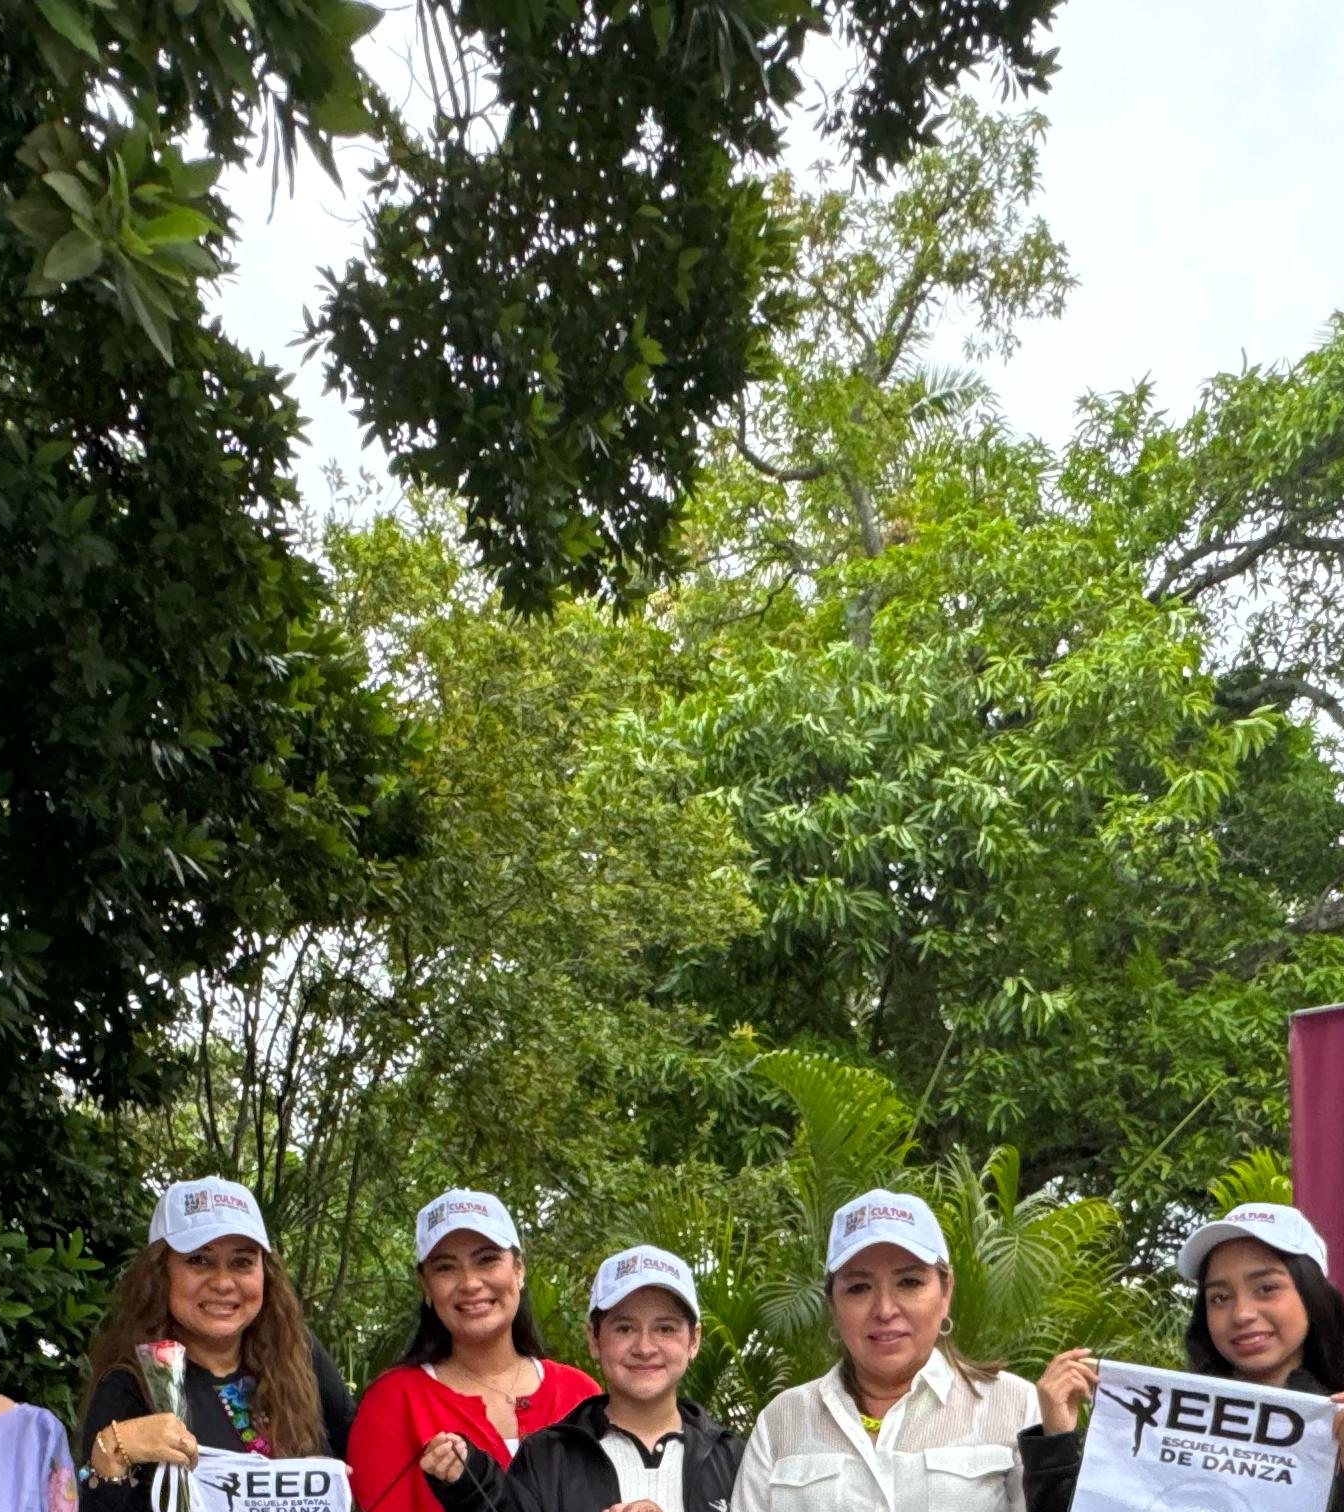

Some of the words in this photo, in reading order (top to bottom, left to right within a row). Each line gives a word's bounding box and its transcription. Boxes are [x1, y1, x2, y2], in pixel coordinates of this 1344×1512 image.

[449, 1203, 488, 1213] CULTURA
[871, 1206, 913, 1221] CULTURA
[643, 1258, 680, 1276] CULTURA
[1165, 1388, 1305, 1447] EED
[1162, 1436, 1229, 1456] ESCUELA
[1233, 1449, 1296, 1468] ESTATAL
[1159, 1448, 1192, 1466] DE
[1202, 1455, 1293, 1484] DANZA
[246, 1471, 331, 1498] EED
